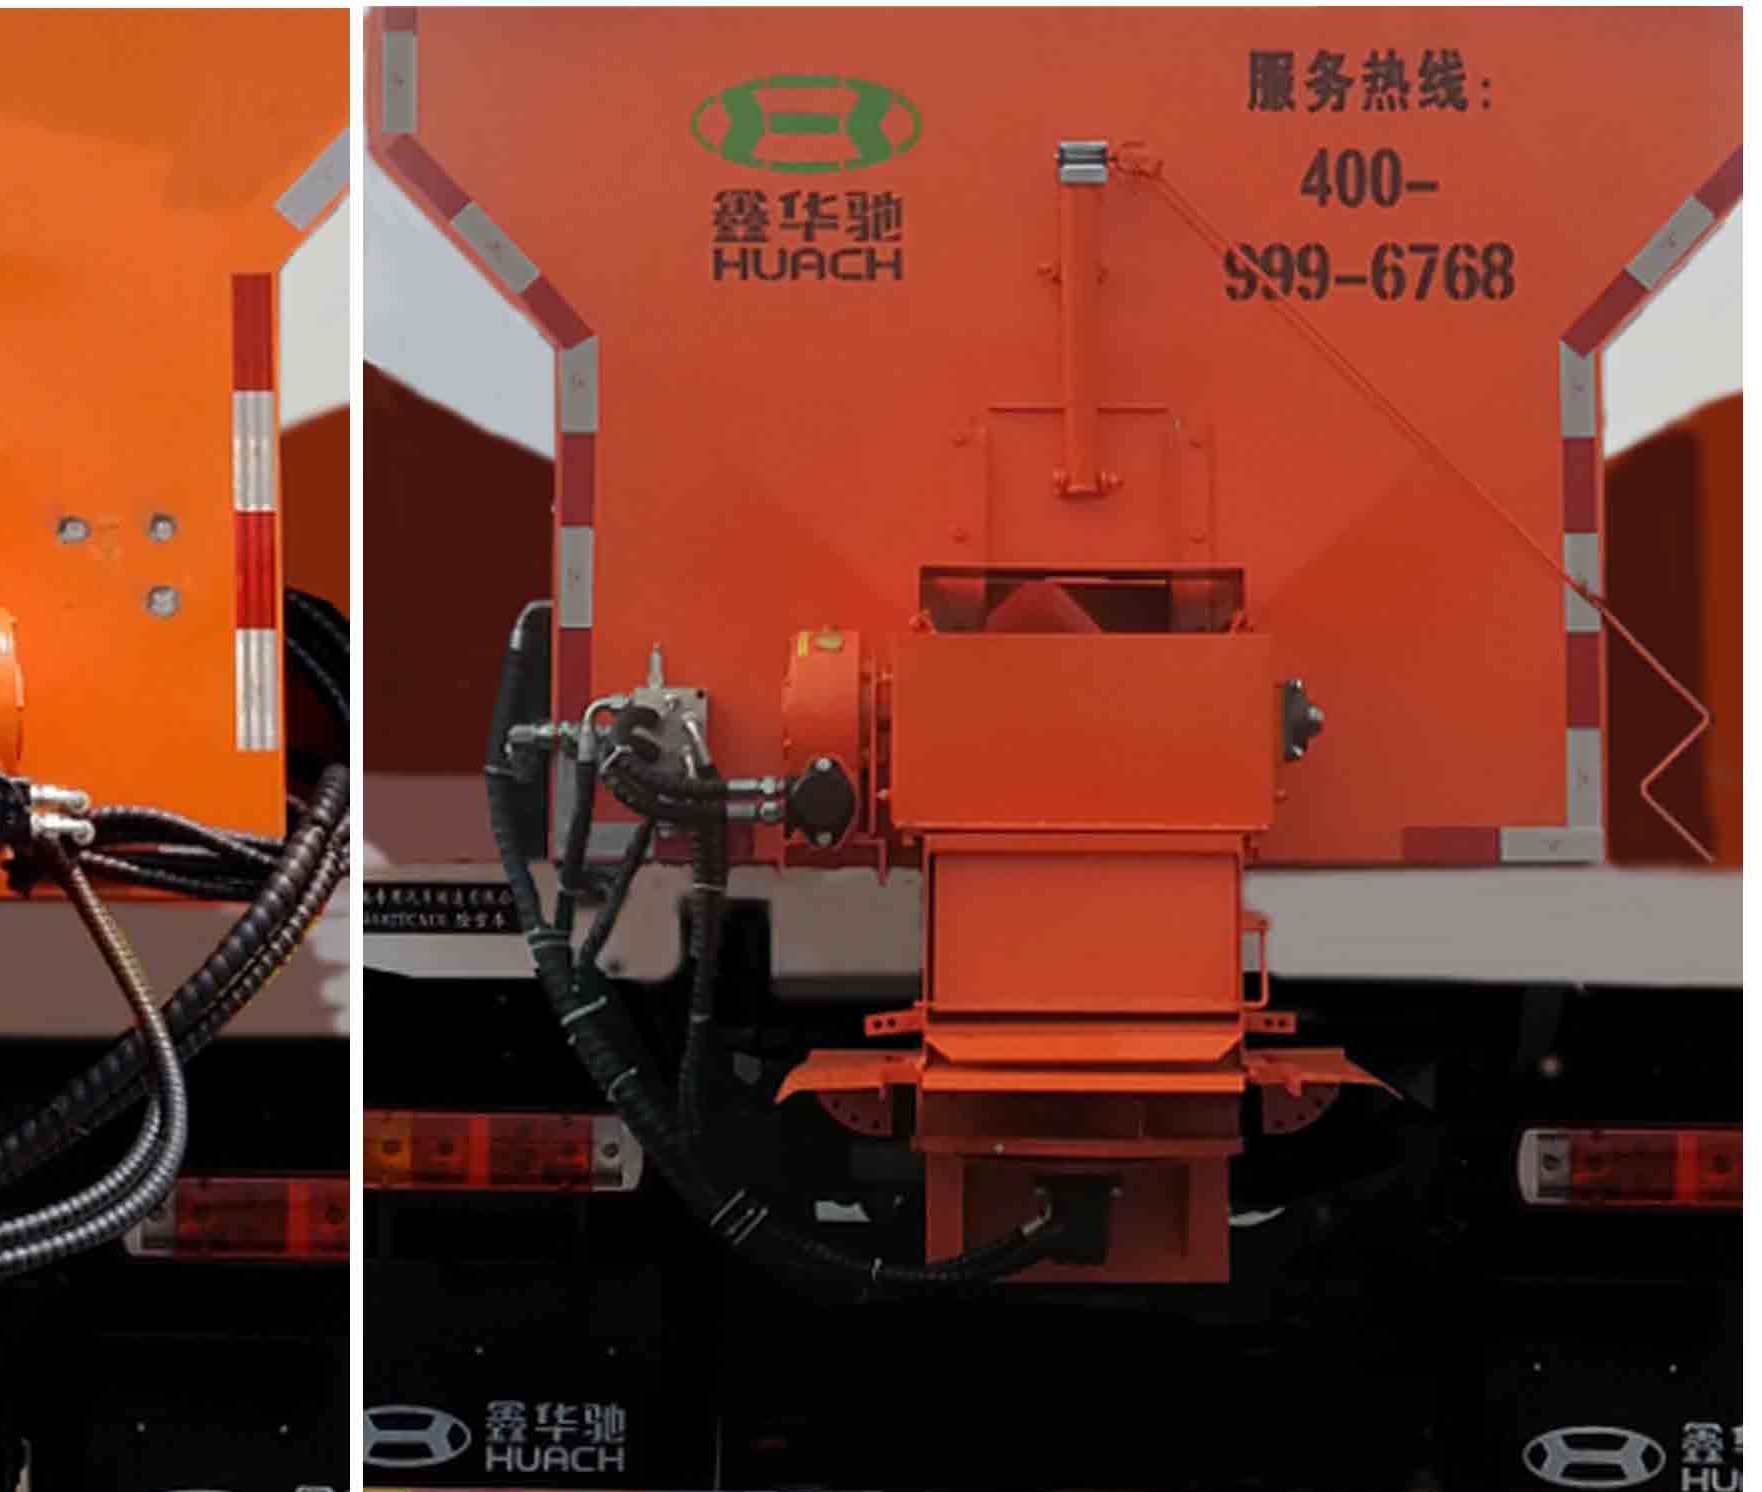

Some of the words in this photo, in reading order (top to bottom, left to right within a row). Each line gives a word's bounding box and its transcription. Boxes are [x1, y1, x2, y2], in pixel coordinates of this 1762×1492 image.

[1247, 49, 1491, 112] 服务热线：
[1300, 147, 1439, 208] 400-
[713, 190, 903, 243] 鑫华驰
[713, 247, 903, 281] HUACH
[1224, 242, 1515, 301] 999-6768
[485, 1400, 627, 1444] 鑫华驰
[1681, 1421, 1743, 1463] 鑫
[485, 1446, 626, 1472] HUACH
[1681, 1468, 1743, 1492] HU
